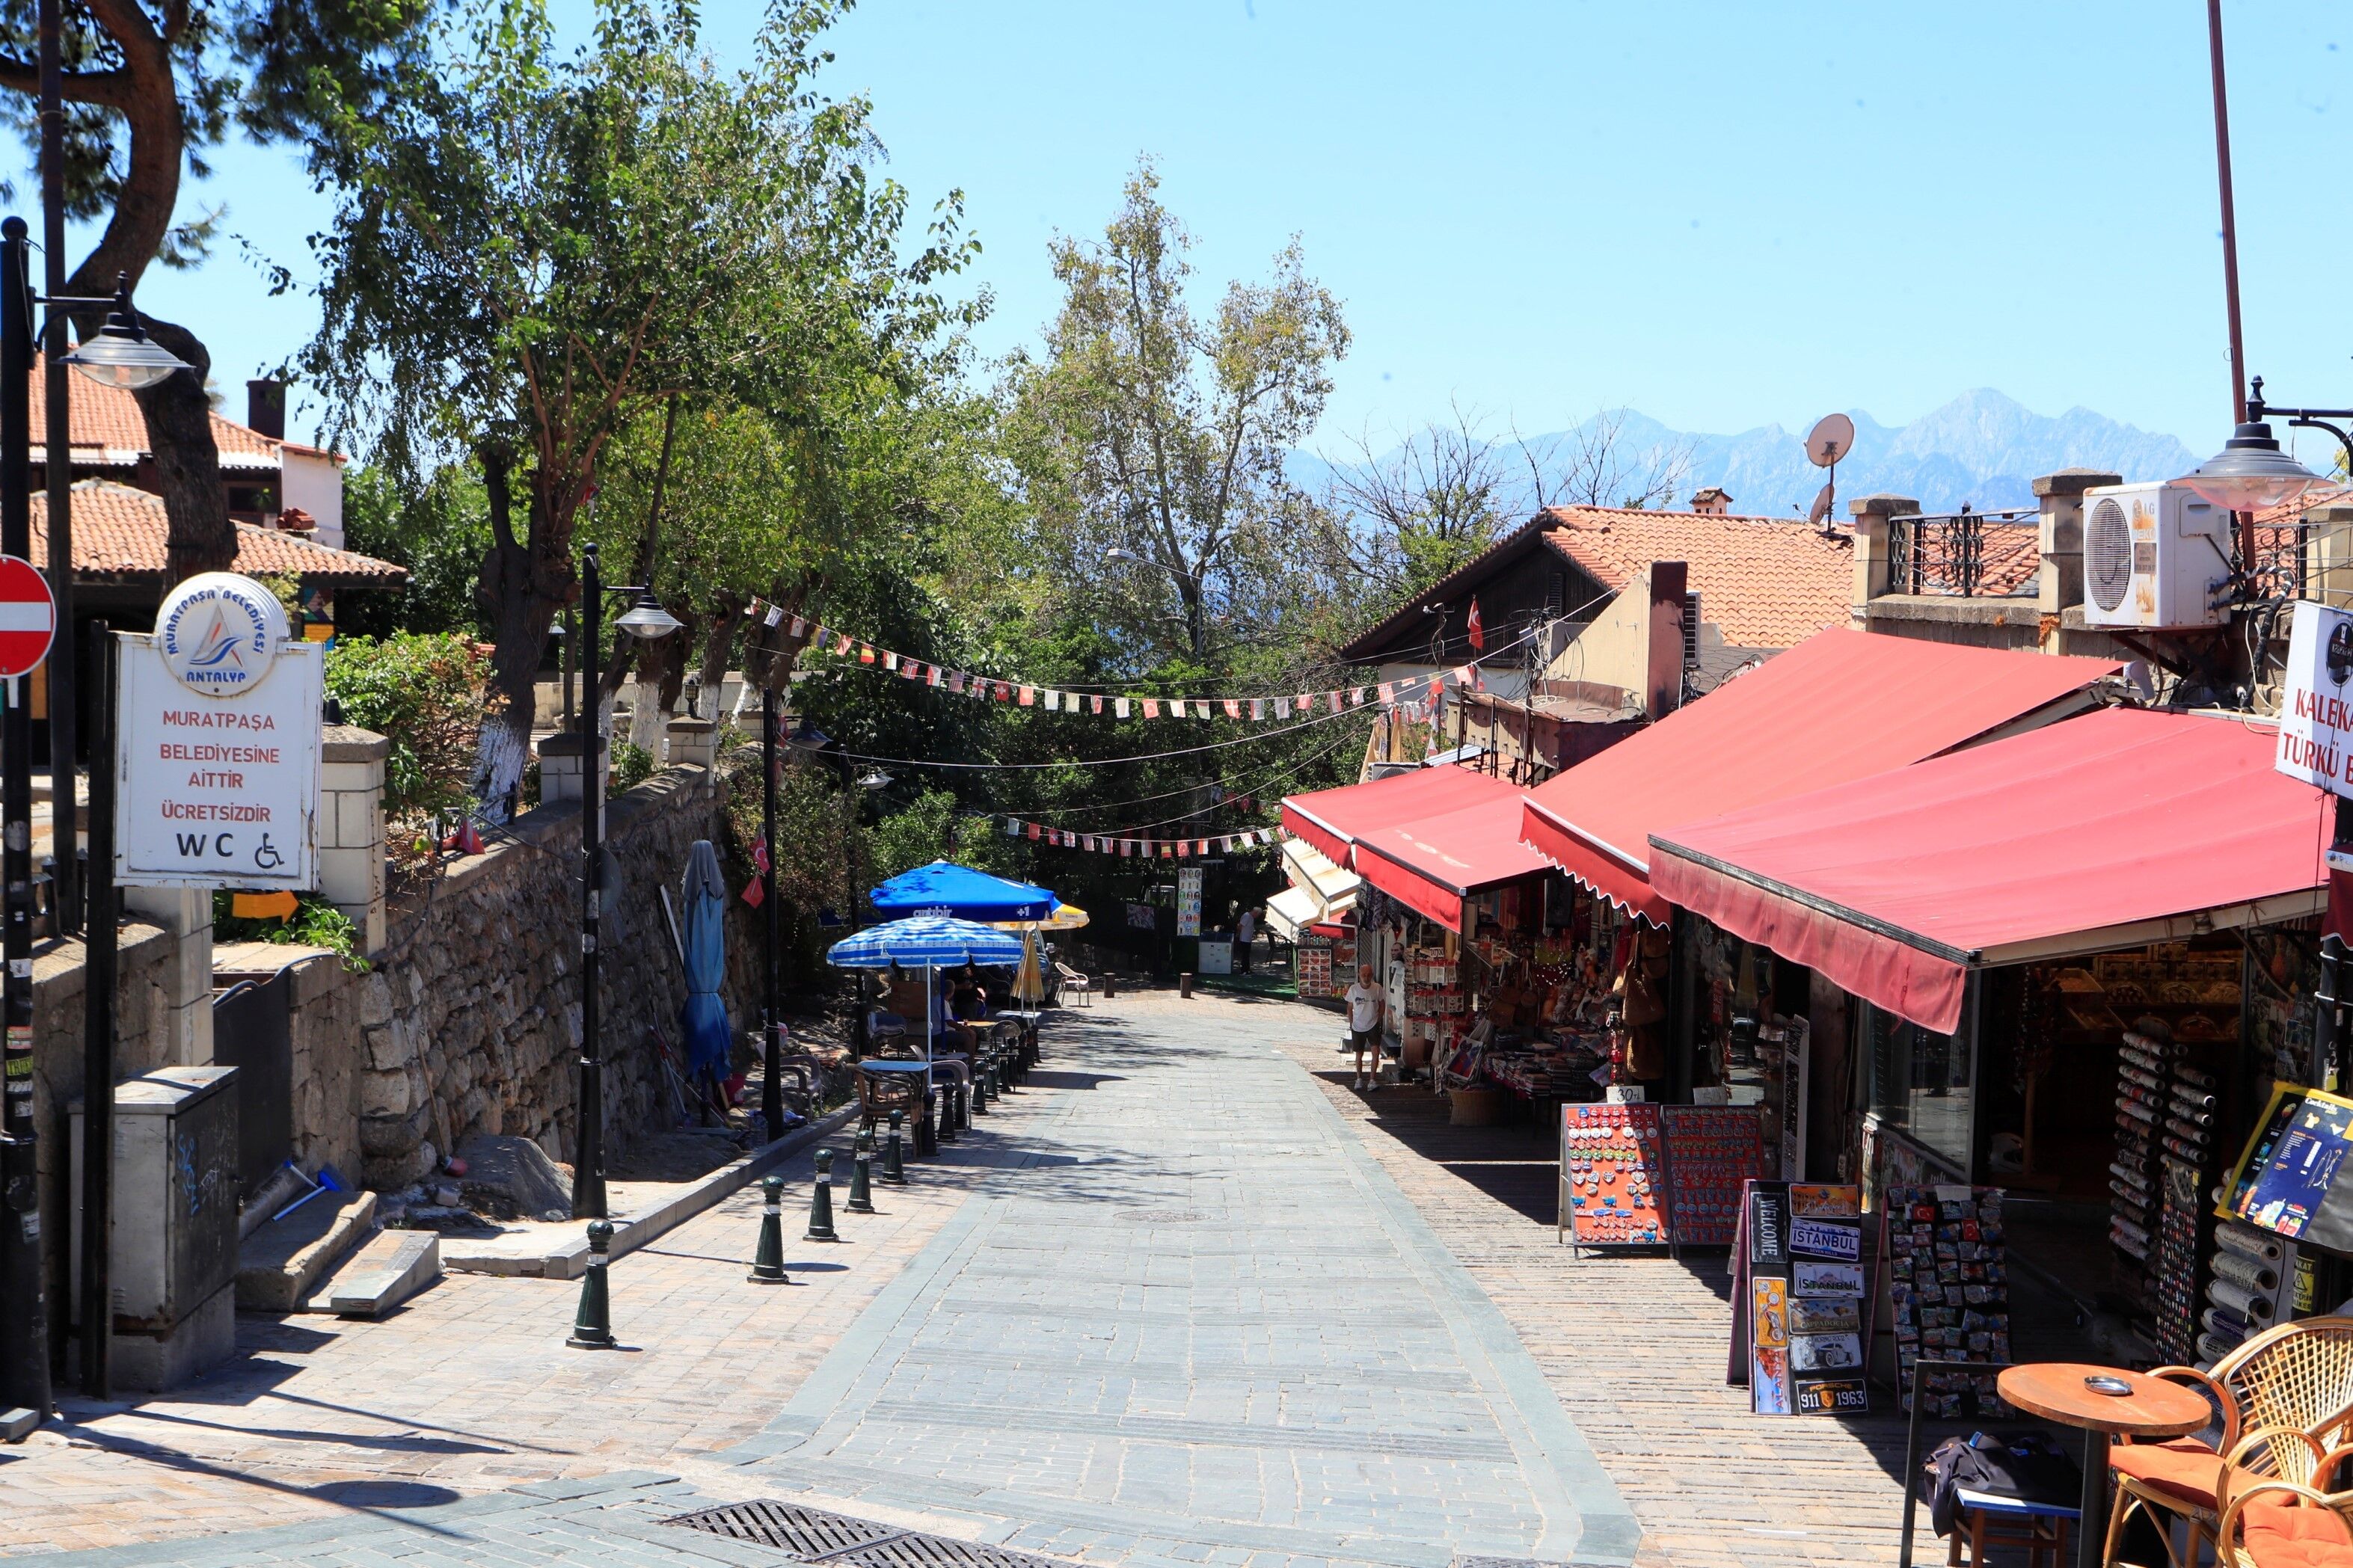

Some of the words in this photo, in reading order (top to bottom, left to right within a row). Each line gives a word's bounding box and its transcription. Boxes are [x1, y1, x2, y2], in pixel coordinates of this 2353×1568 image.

[163, 710, 275, 731] MURATPAŞA
[160, 743, 280, 763] BELEDİYESİNE
[2283, 729, 2340, 778] TÜRKÜ
[188, 769, 244, 788] AİTTİR
[162, 799, 271, 823] ÜCRETSİZDİR
[1760, 1199, 1779, 1256] WELCOME
[1800, 1392, 1820, 1408] 911
[1835, 1390, 1865, 1406] 1963
